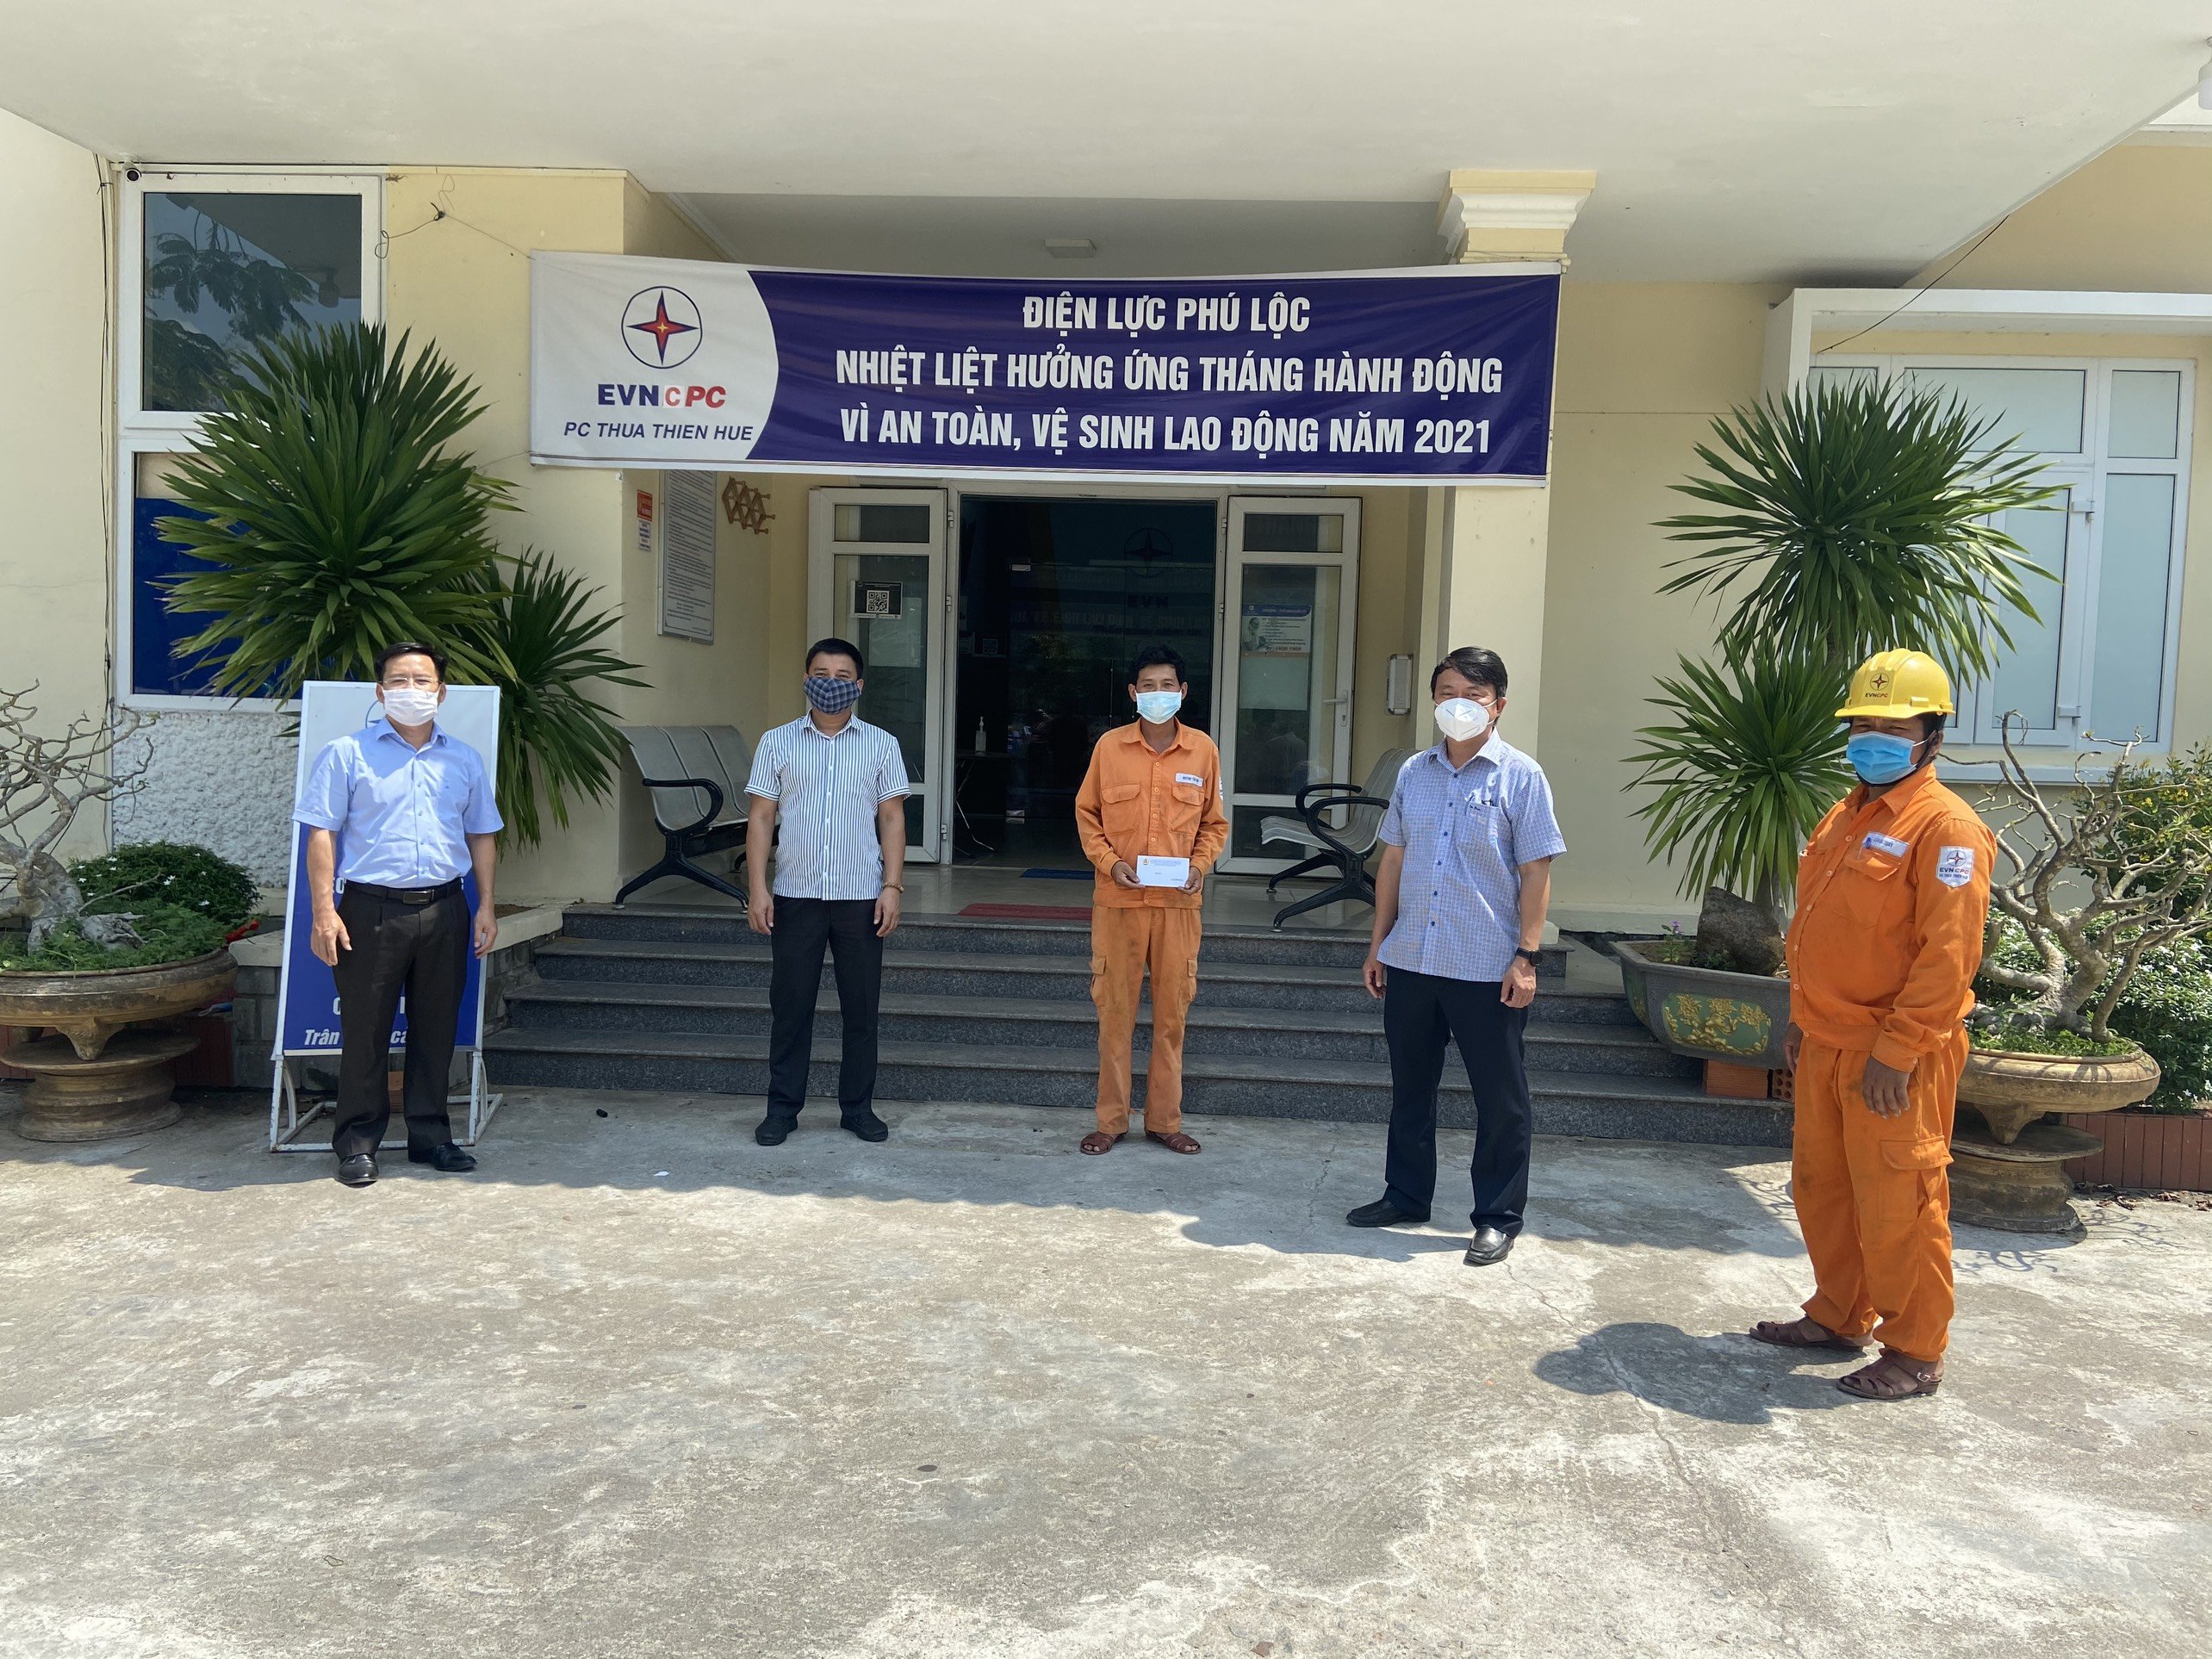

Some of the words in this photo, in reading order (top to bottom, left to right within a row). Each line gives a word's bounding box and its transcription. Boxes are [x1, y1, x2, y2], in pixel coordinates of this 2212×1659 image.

[1022, 290, 1097, 337] ĐIỆN
[1107, 295, 1165, 338] LỰC
[1176, 291, 1240, 332] PHÚ
[1250, 291, 1310, 339] LỘC
[836, 344, 925, 393] NHIỆT
[935, 345, 997, 395] LIỆT
[1007, 343, 1114, 389] HƯỞNG
[1124, 348, 1189, 391] ỨNG
[1199, 350, 1303, 392] THÁNG
[1314, 351, 1402, 393] HÀNH
[1412, 351, 1502, 401] ĐỘNG
[564, 422, 591, 437] PC
[597, 423, 644, 438] THUA
[653, 424, 708, 439] THIEN
[714, 426, 753, 440] HUE
[840, 401, 869, 443] VÌ
[878, 409, 922, 443] AN
[932, 405, 1021, 450] TOÀN,
[1031, 407, 1069, 455] VỆ
[1078, 414, 1154, 450] SINH
[1164, 416, 1221, 451] LAO
[1231, 409, 1319, 459] ĐỘNG
[1329, 410, 1404, 453] NĂM
[1414, 419, 1489, 454] 2021
[304, 1028, 339, 1045] Trân
